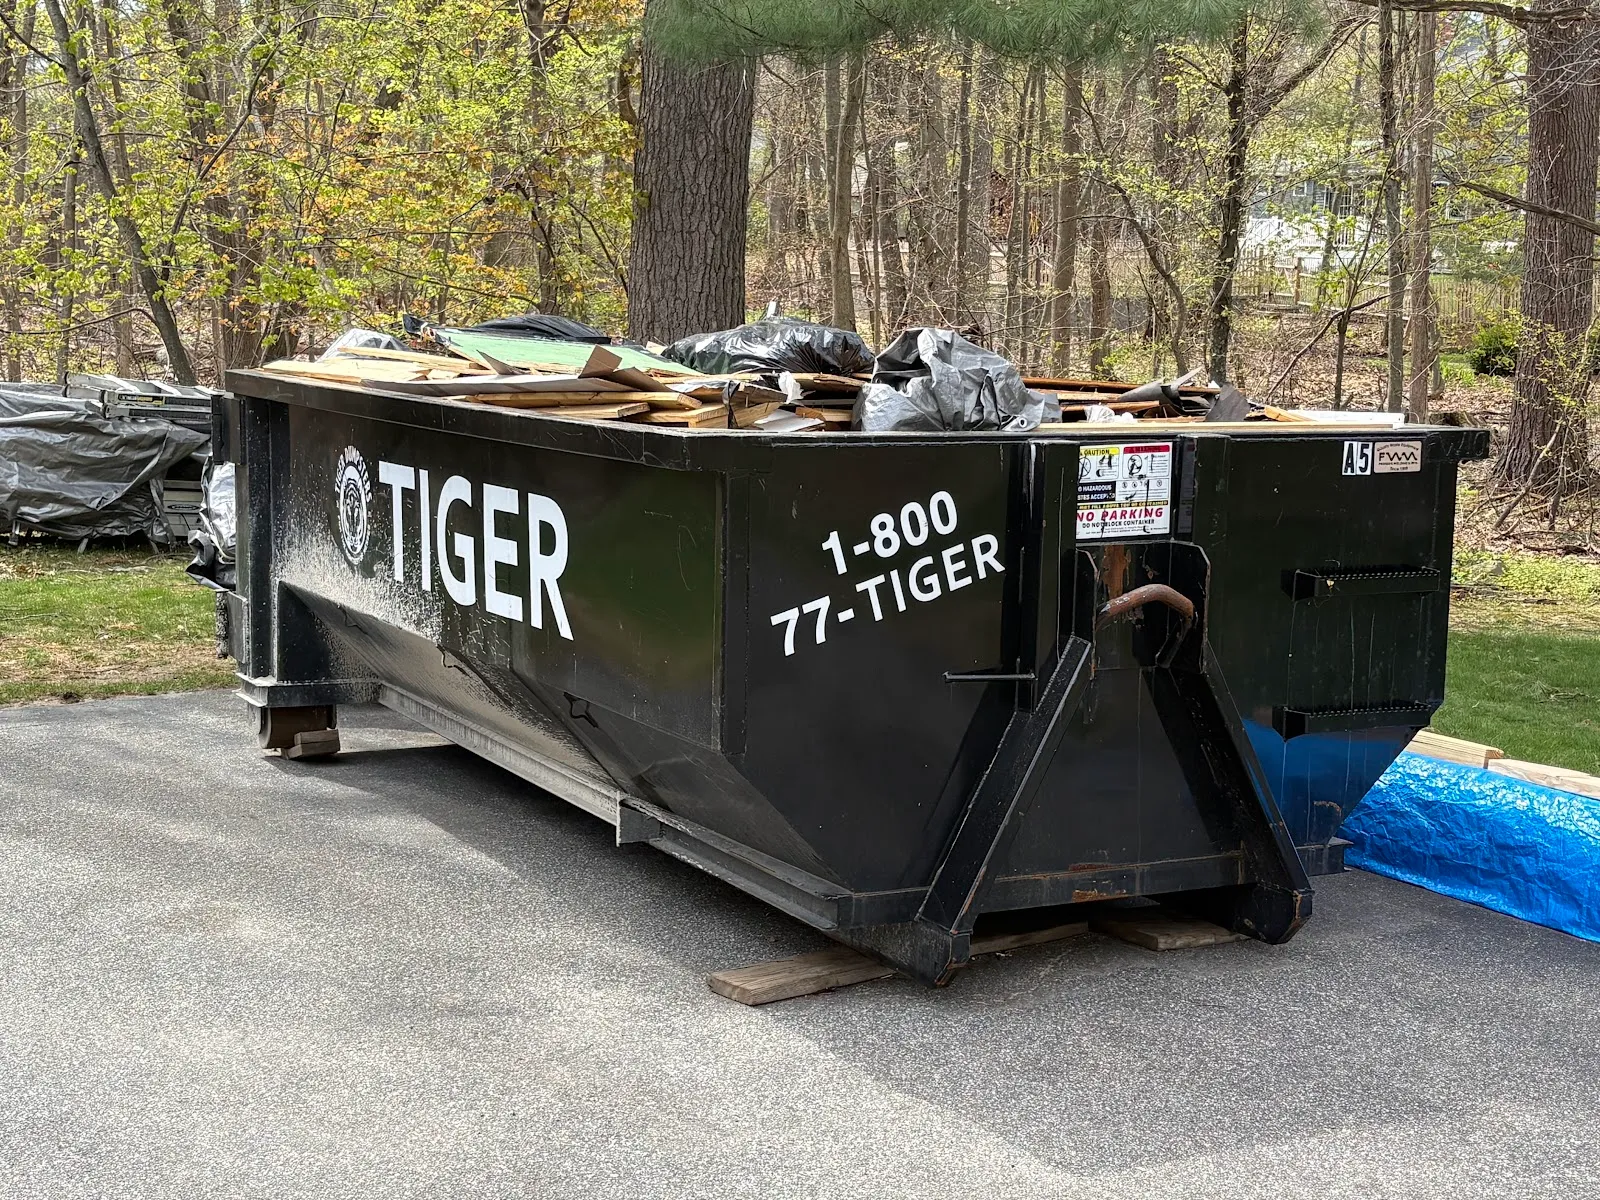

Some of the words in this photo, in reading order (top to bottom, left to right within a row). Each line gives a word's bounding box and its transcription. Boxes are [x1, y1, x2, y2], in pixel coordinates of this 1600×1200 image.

[1084, 449, 1110, 457] CAUTION
[1344, 443, 1370, 473] A5
[1082, 484, 1112, 492] HAZARDOUS
[1076, 511, 1095, 522] NO
[1101, 507, 1163, 521] PARKING
[821, 490, 958, 575] 1-800
[378, 460, 574, 641] TIGER
[770, 533, 1005, 657] 77-TIGER
